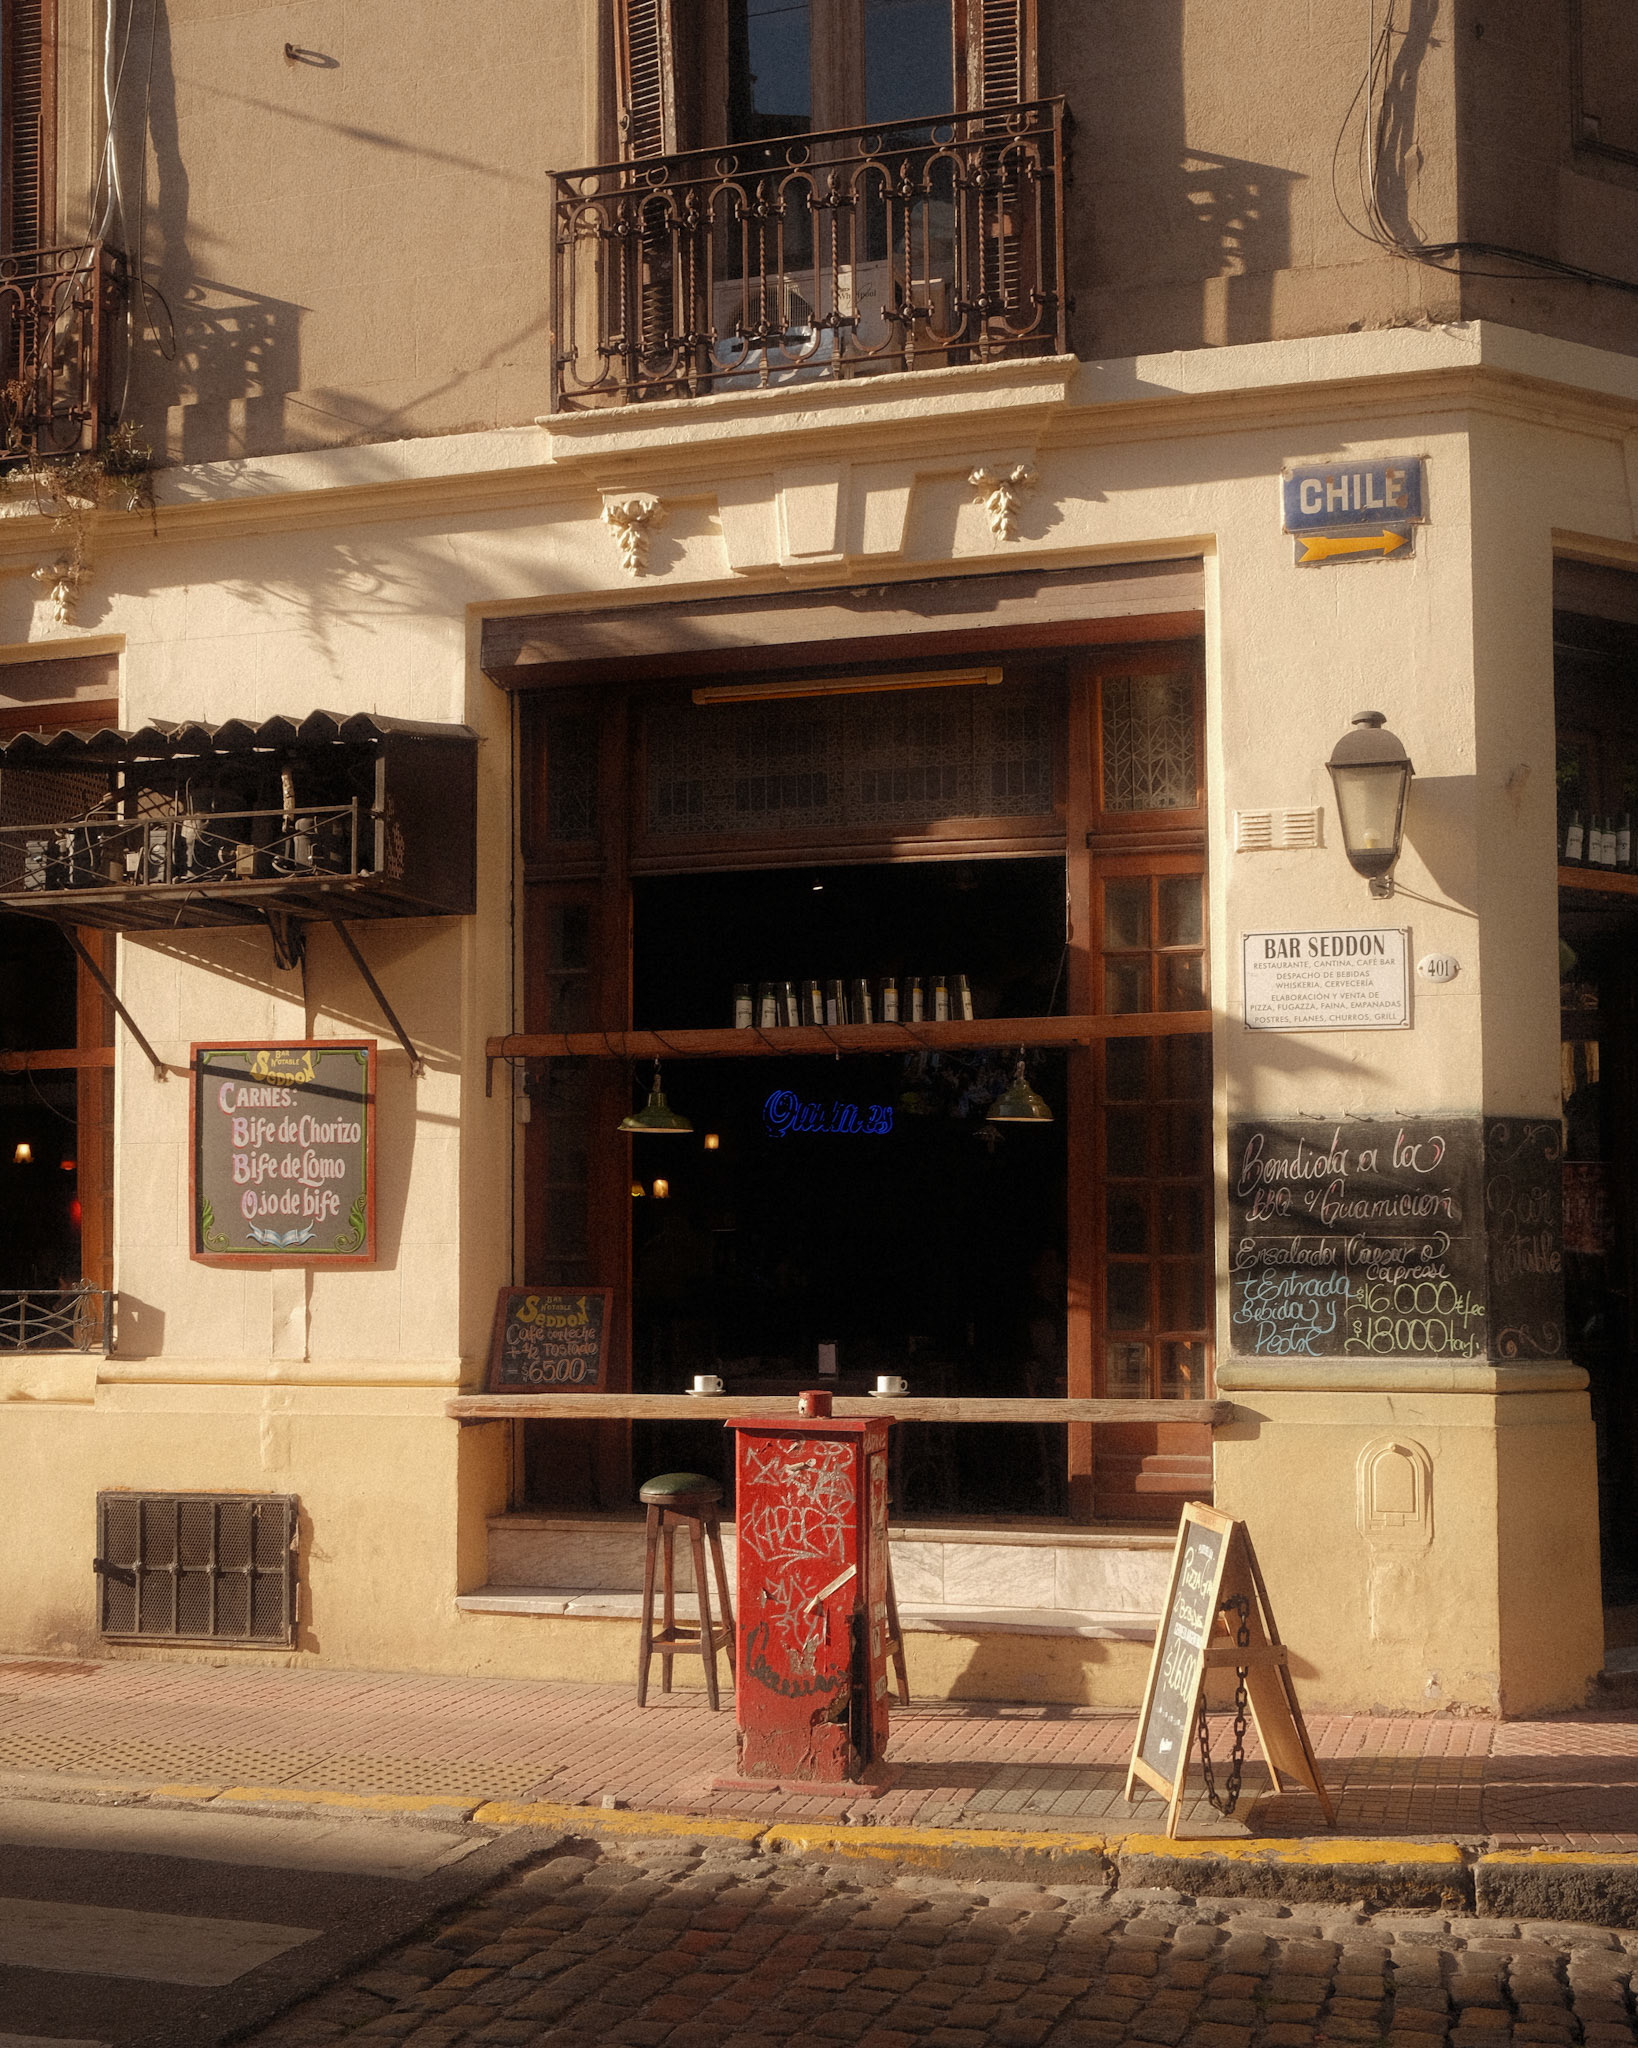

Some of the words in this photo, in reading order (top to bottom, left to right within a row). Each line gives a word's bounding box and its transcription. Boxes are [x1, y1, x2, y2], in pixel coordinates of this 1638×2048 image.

[1300, 470, 1407, 514] CHILE
[1265, 938, 1301, 959] BAR
[1308, 935, 1385, 958] SEDDON
[1253, 961, 1311, 969] RESTAURANTE,
[1313, 960, 1354, 968] CANTINA,
[1356, 958, 1377, 966] CAFÉ
[1276, 971, 1321, 980] DESPACHO
[1336, 970, 1370, 978] BEBIDAS
[1427, 959, 1450, 977] 401
[1271, 993, 1330, 1002] ELABORACIÓN
[1275, 981, 1321, 989] WHISKERIA,
[1324, 979, 1374, 988] CERVECERÍA
[1254, 1016, 1292, 1024] POSTRES,
[1329, 1013, 1372, 1021] CHURROS,
[1277, 1003, 1318, 1011] FUGAZZA,
[1321, 1002, 1348, 1010] FAINA,
[1350, 1000, 1402, 1008] EMPANADAS
[218, 1082, 298, 1114] CARNES:
[231, 1116, 276, 1148] Bife
[278, 1115, 298, 1143] de
[299, 1115, 361, 1147] Chorizo
[232, 1151, 277, 1184] Bife
[280, 1152, 300, 1179] de
[298, 1149, 346, 1188] Lomo
[1238, 1126, 1349, 1197] Bondiola
[1357, 1149, 1378, 1173] a
[1392, 1128, 1446, 1173] la
[241, 1190, 279, 1219] Ojo
[279, 1188, 300, 1215] de
[303, 1187, 341, 1222] bife
[1228, 1237, 1338, 1273] Ensalada
[1344, 1281, 1458, 1318] $16.000
[1232, 1299, 1320, 1324] Bebida
[1311, 1300, 1336, 1334] y
[506, 1323, 545, 1345] Café
[1255, 1320, 1324, 1357] Postre
[1344, 1316, 1449, 1354] $18.000
